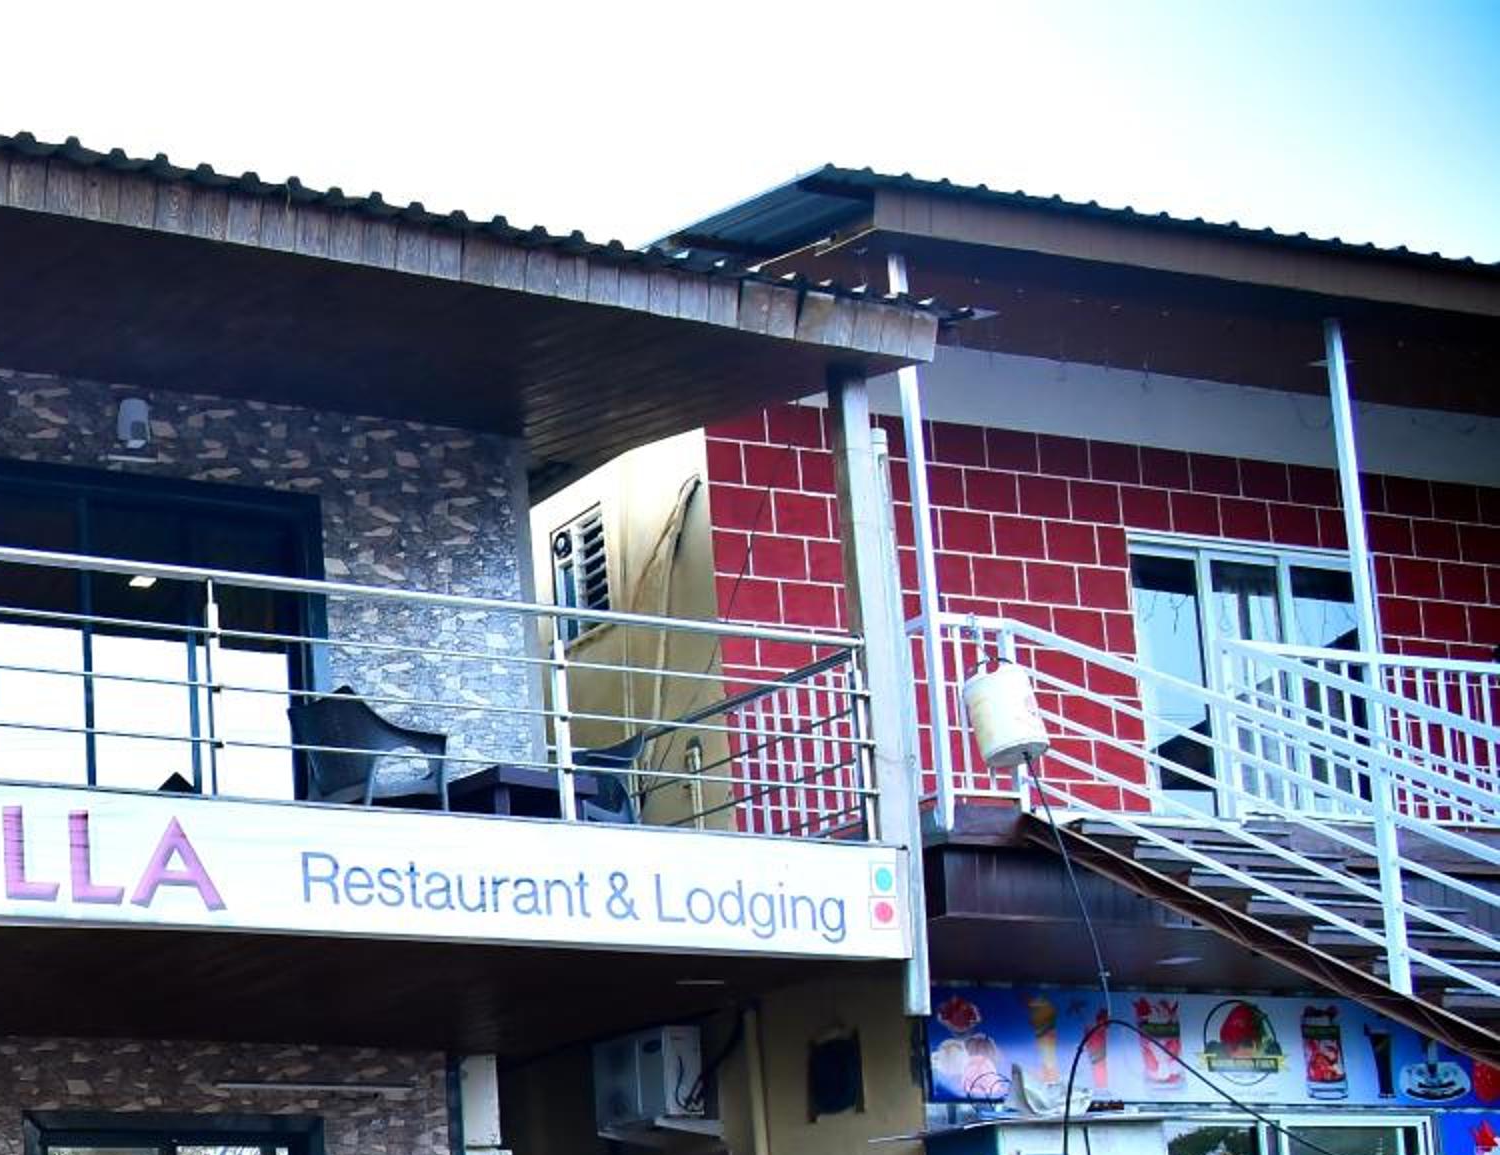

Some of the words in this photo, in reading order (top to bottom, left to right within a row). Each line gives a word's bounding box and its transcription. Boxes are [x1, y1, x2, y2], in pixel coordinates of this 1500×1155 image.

[300, 850, 592, 918] Restaurant
[606, 871, 639, 921] &
[654, 880, 847, 944] Lodging
